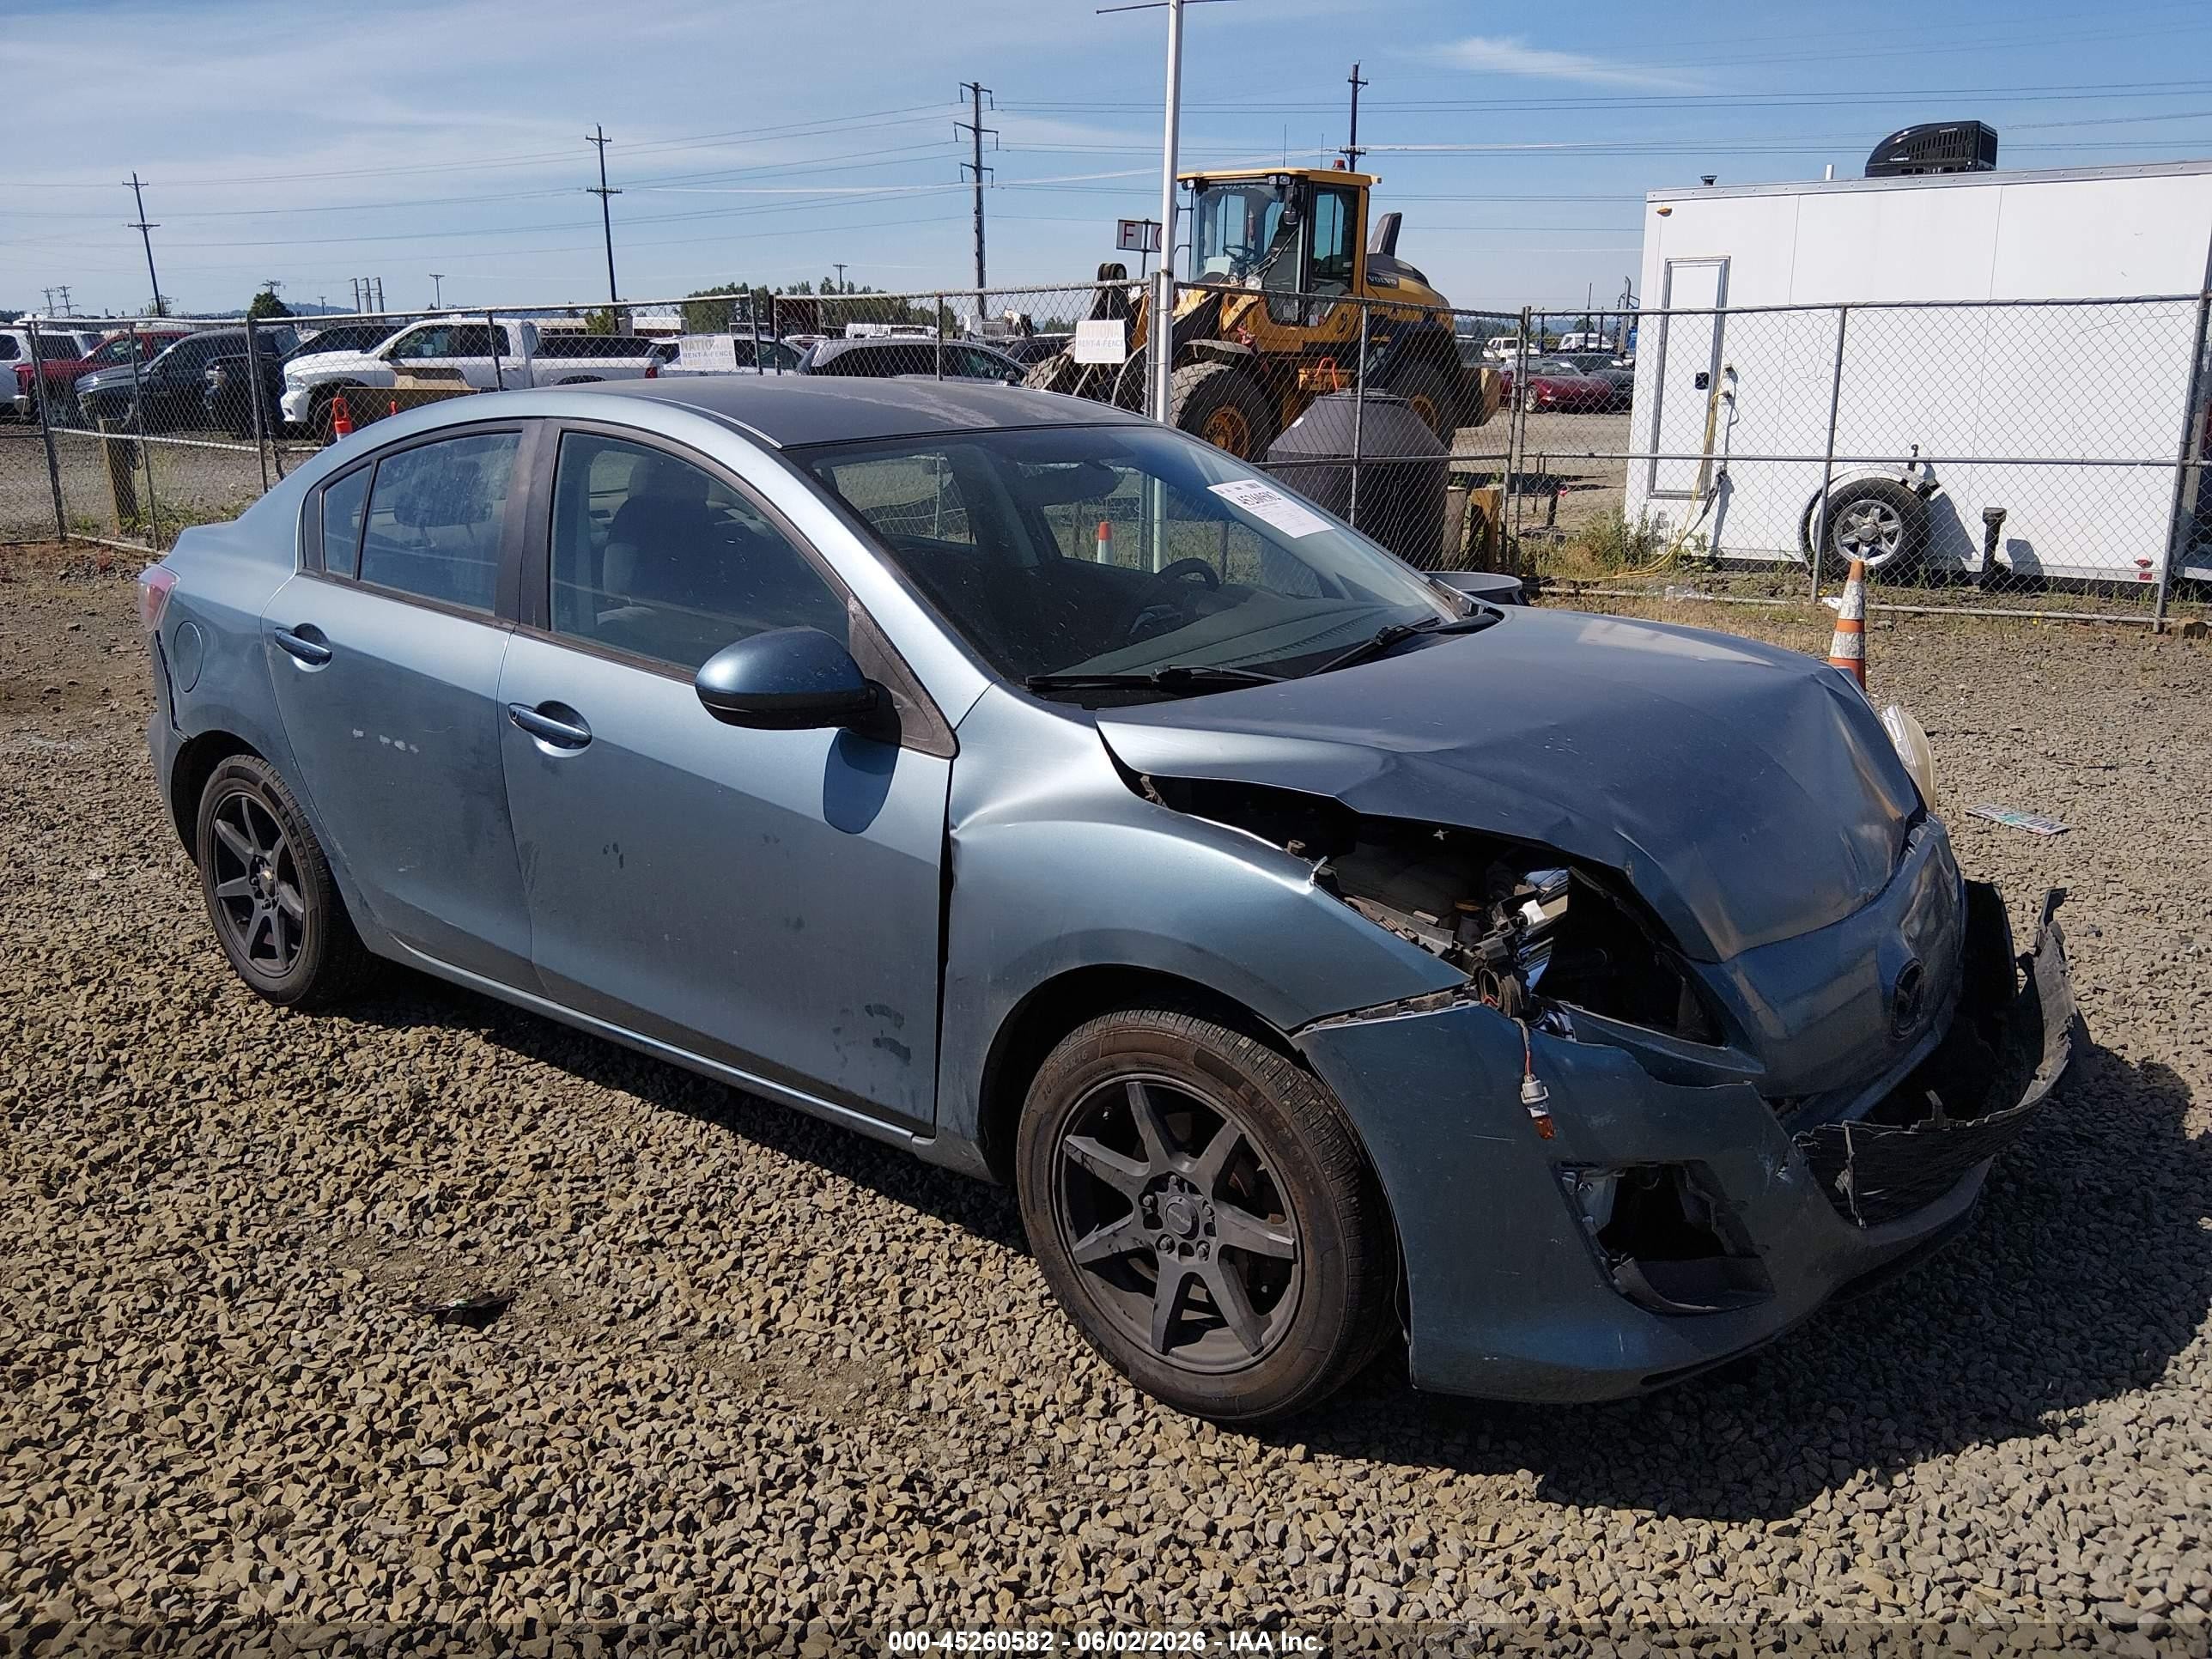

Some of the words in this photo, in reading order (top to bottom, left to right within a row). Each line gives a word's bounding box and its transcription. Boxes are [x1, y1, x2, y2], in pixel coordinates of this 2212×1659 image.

[1122, 222, 1135, 247] F
[1366, 275, 1397, 285] VOLVO
[683, 349, 733, 358] RENT-A-FENCE
